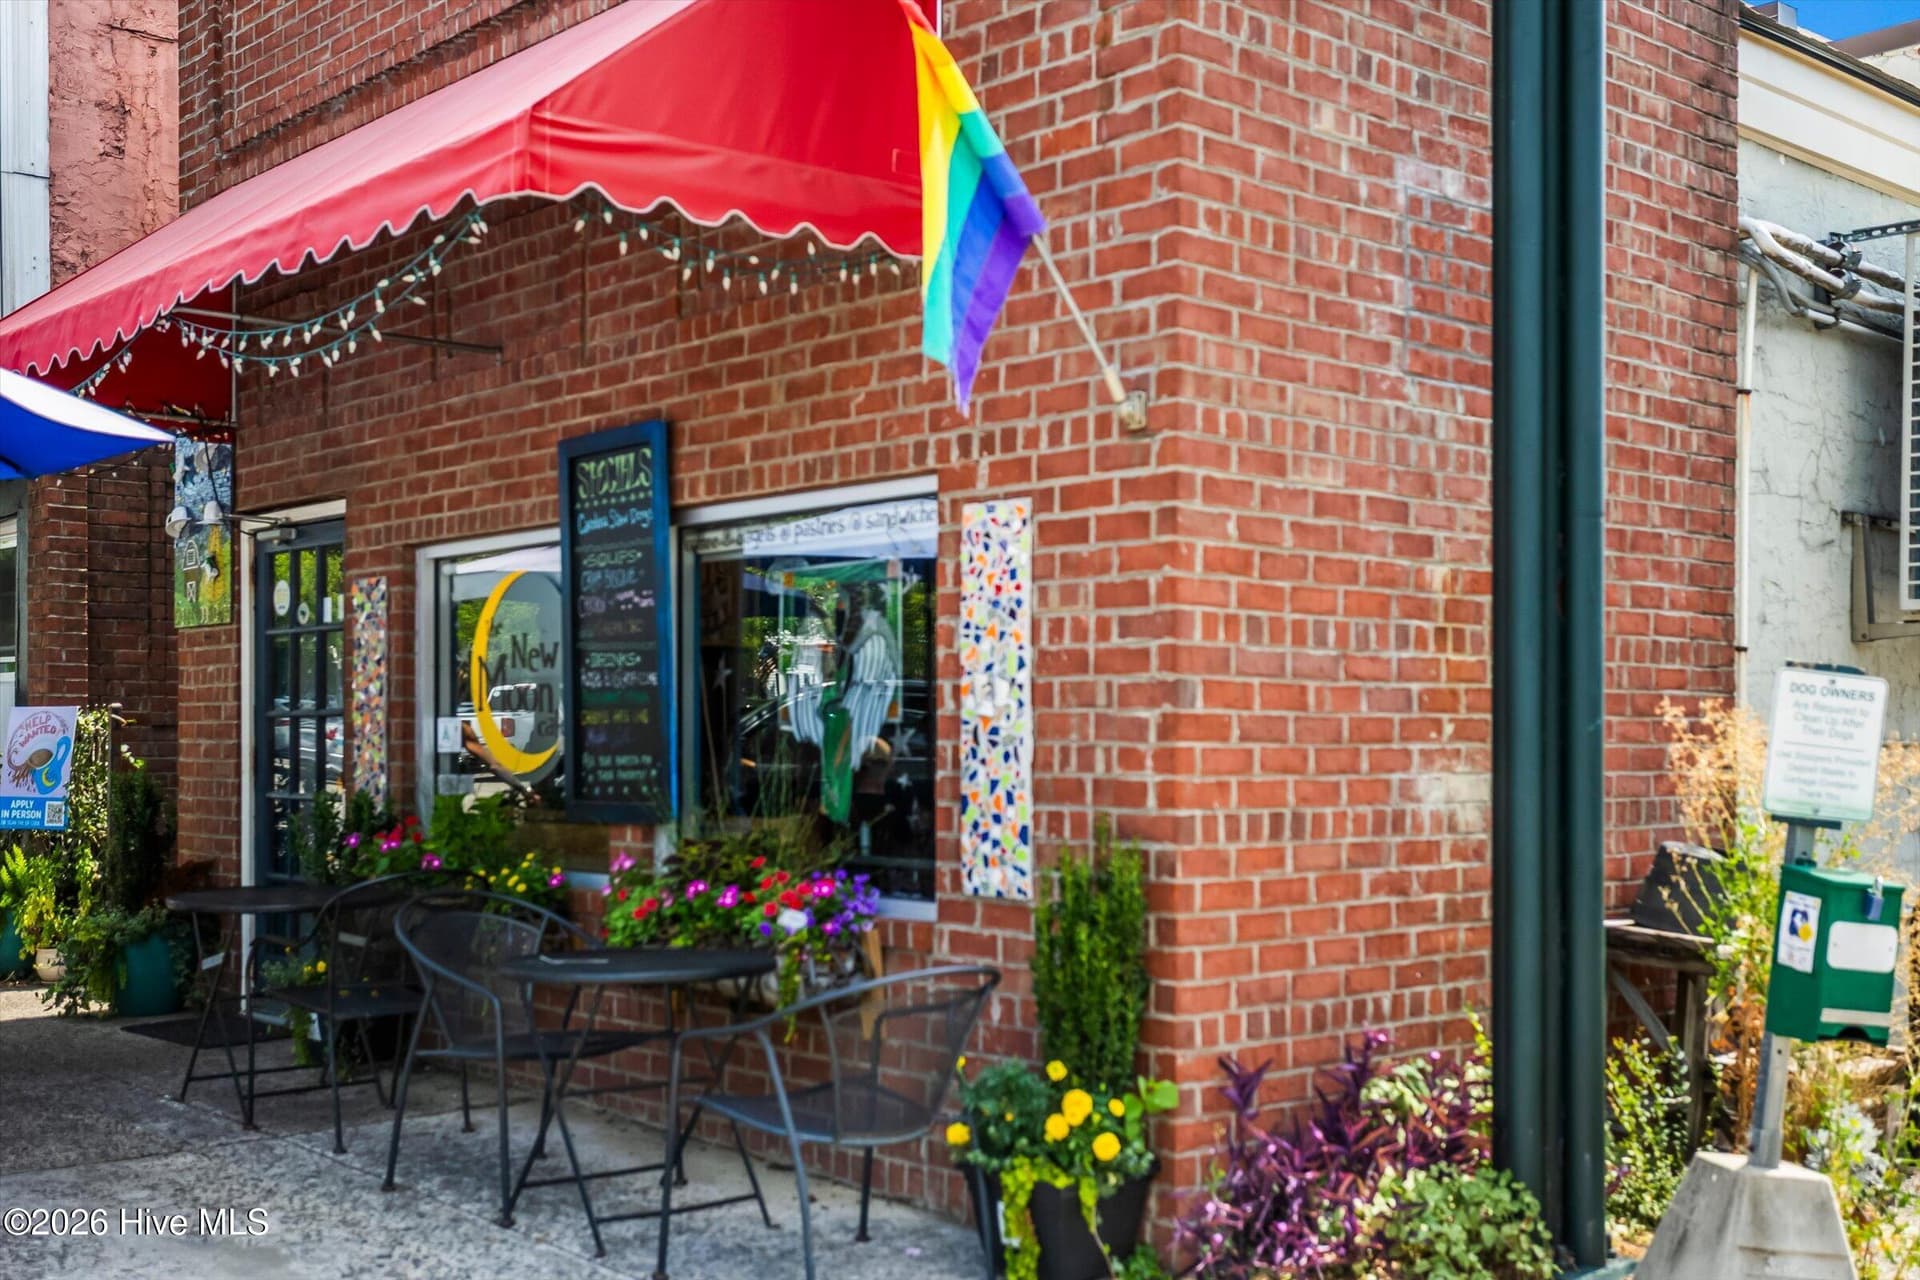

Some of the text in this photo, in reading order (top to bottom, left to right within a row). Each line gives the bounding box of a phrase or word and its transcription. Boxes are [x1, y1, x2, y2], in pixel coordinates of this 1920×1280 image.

[510, 632, 560, 672] New
[477, 654, 554, 713] Moon
[1789, 682, 1877, 702] DOG OWNERS
[24, 714, 52, 731] HELP
[10, 799, 35, 809] APPLY
[1, 809, 42, 819] IN PERSON
